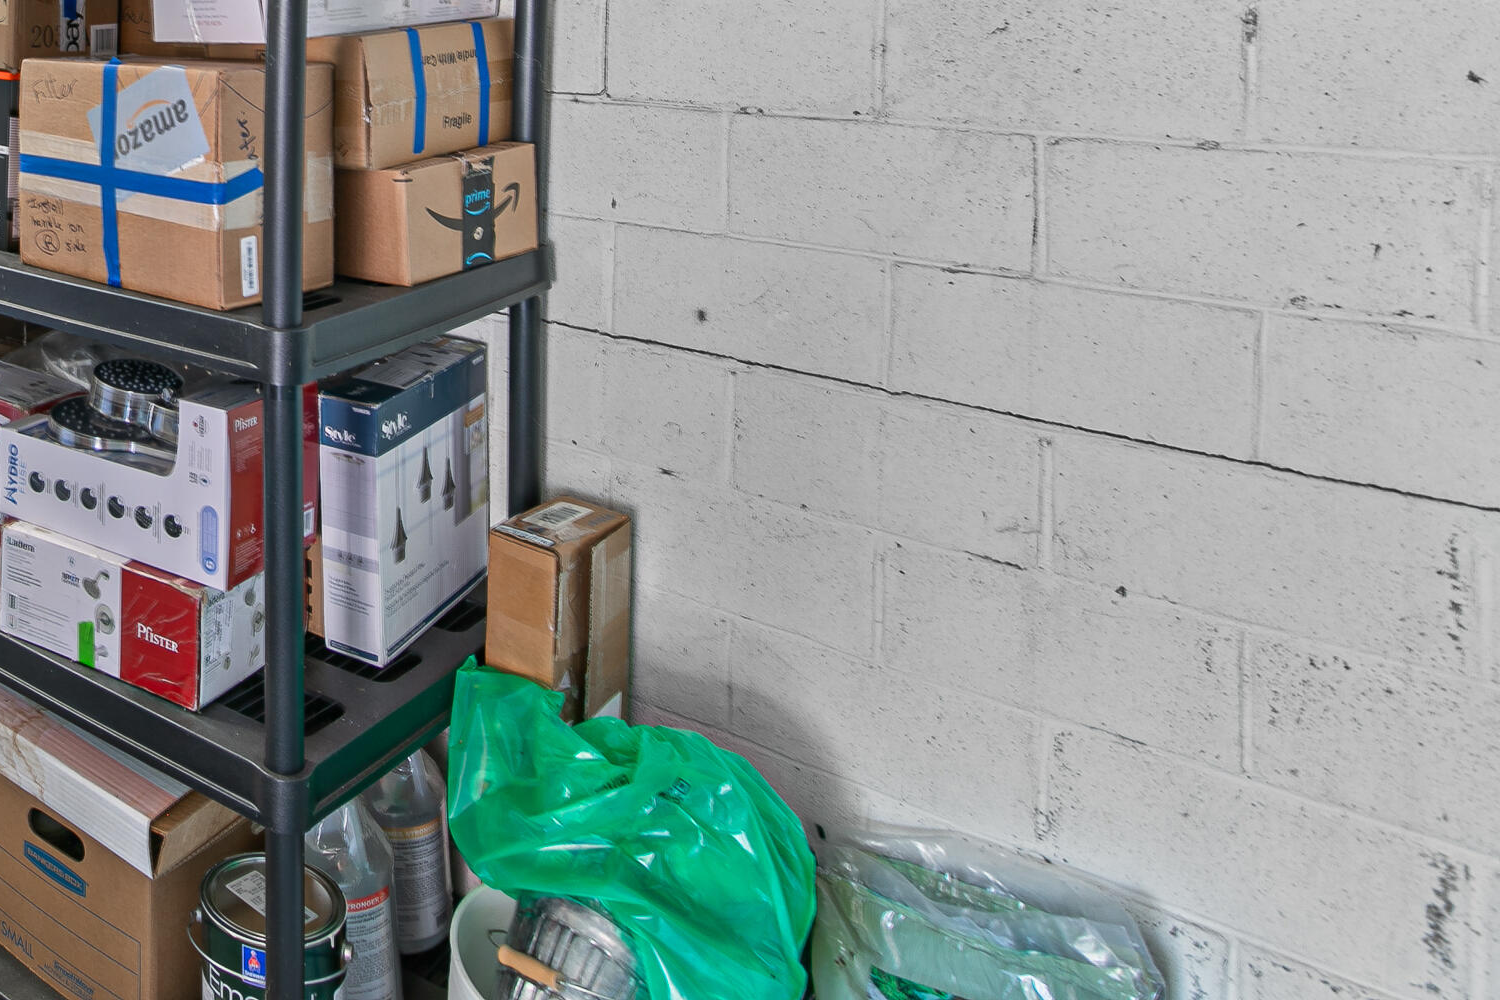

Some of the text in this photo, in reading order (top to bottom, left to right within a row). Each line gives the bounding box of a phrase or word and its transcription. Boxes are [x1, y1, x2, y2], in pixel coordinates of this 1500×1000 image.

[438, 51, 457, 65] With
[116, 99, 189, 160] amazo
[443, 112, 472, 129] Fragile
[465, 188, 490, 207] prime
[65, 872, 84, 892] BOX
[347, 896, 380, 911] TRONGER
[0, 920, 35, 960] SMALL
